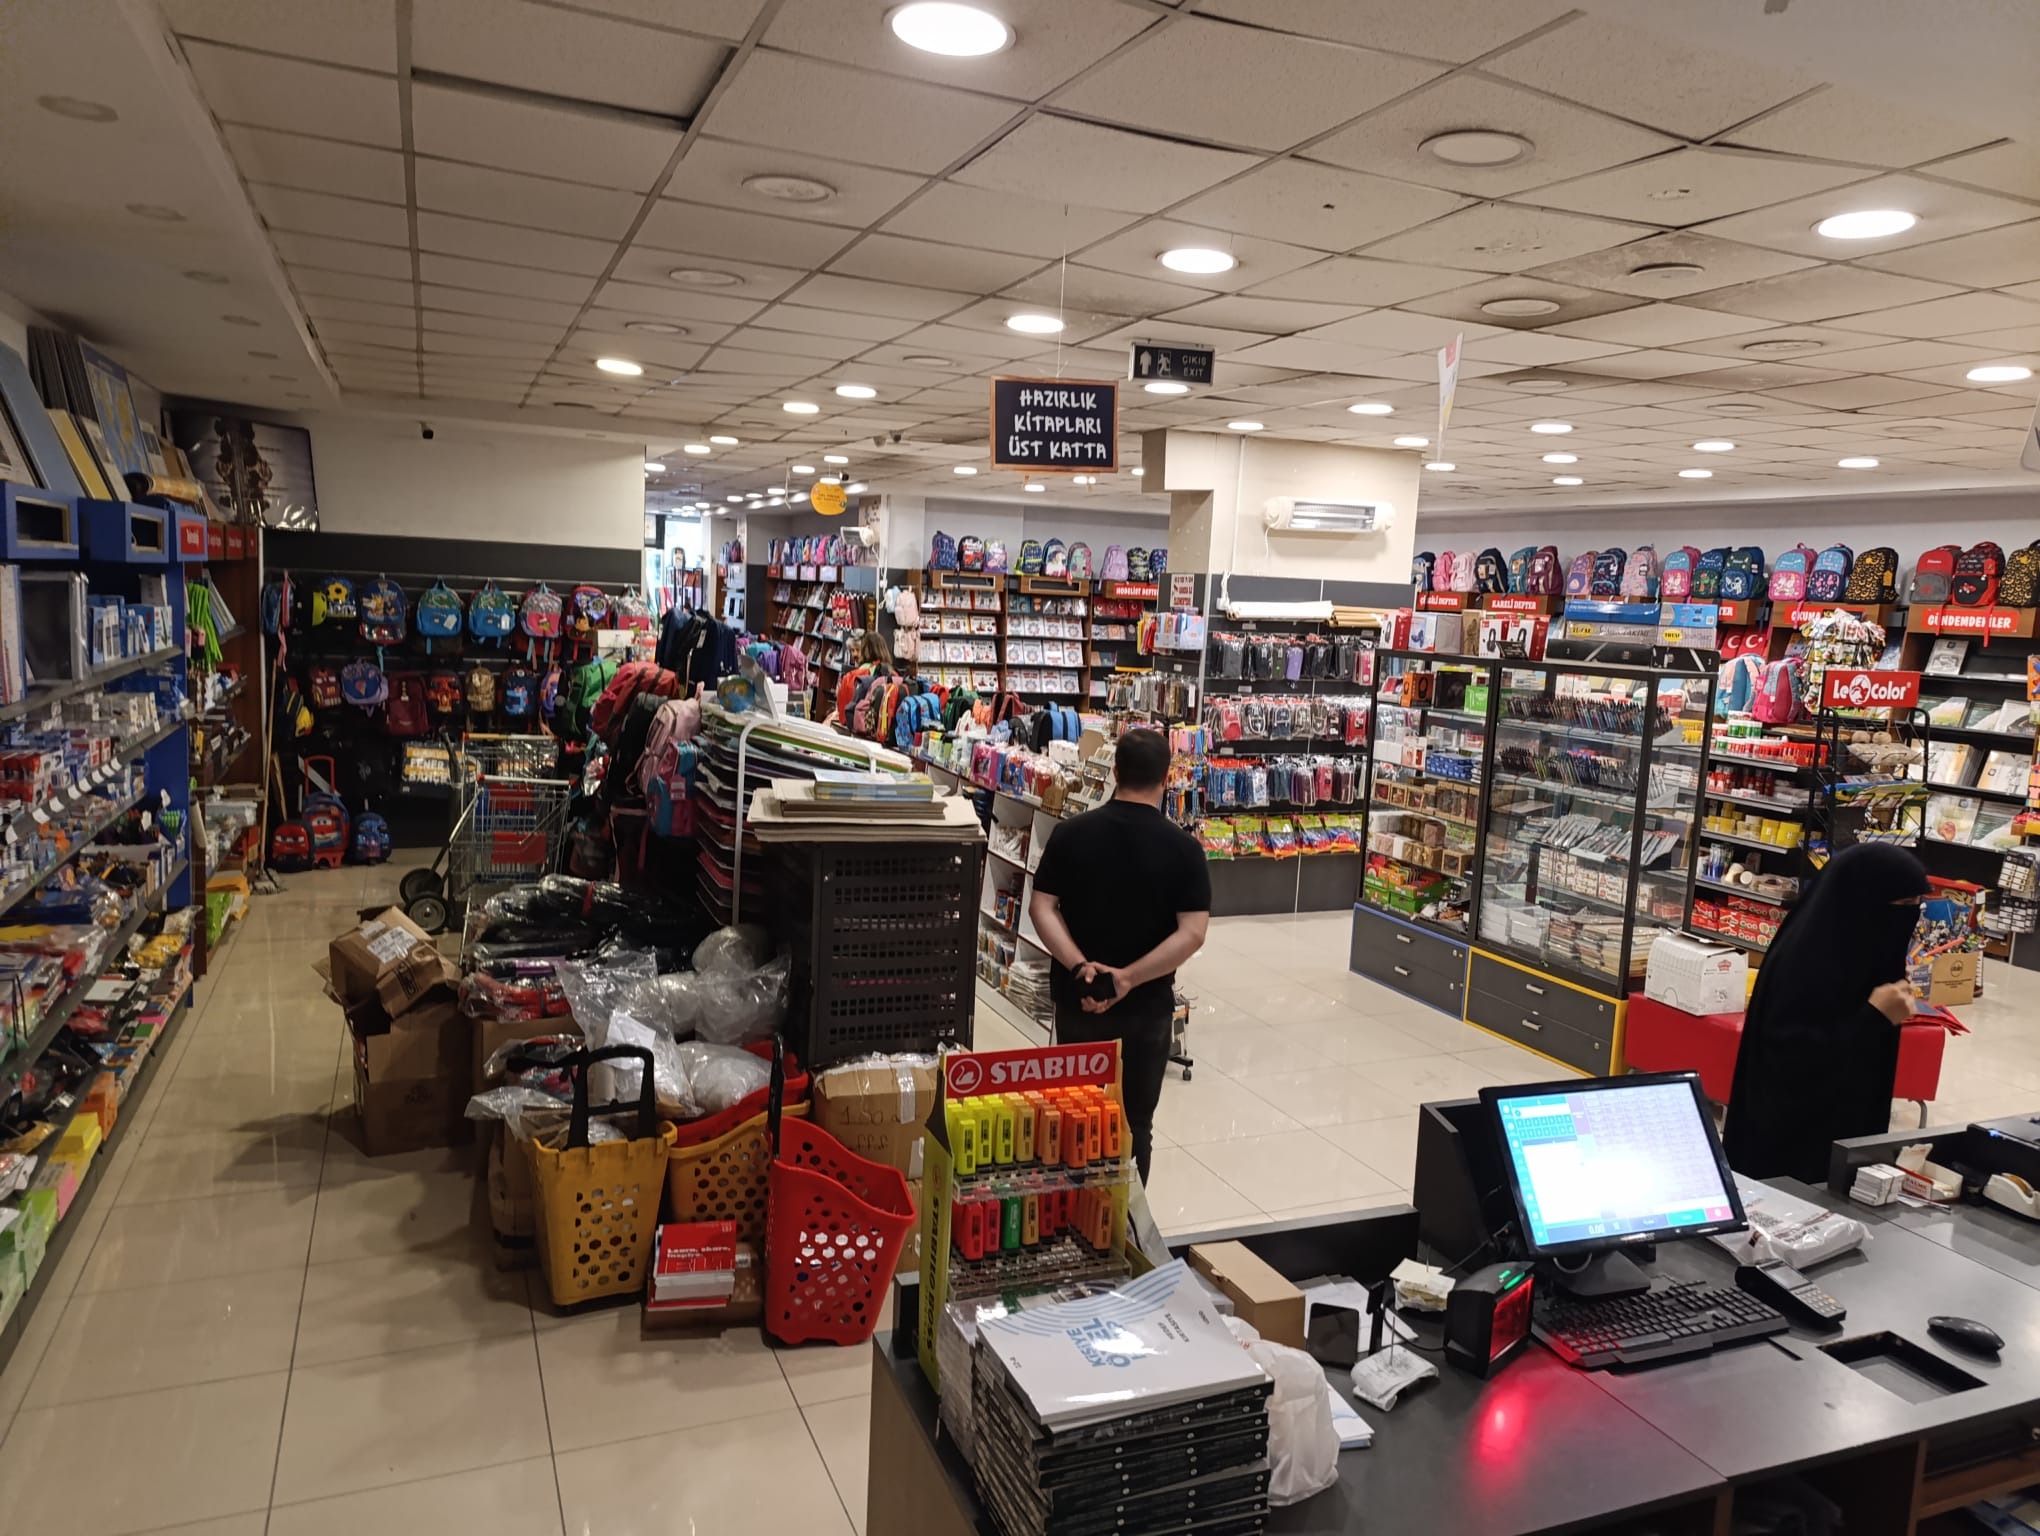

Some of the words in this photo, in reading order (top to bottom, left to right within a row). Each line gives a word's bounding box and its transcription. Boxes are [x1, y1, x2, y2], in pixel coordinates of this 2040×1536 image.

[1183, 367, 1204, 377] EXIT
[1020, 389, 1097, 409] HAZIRLIK
[1014, 411, 1101, 435] KİTAPLARI
[1008, 436, 1043, 457] ÜST
[1050, 440, 1107, 460] KATTA
[990, 1052, 1110, 1085] STABILO
[929, 1197, 939, 1291] STABILO
[926, 1290, 935, 1350] BOSS
